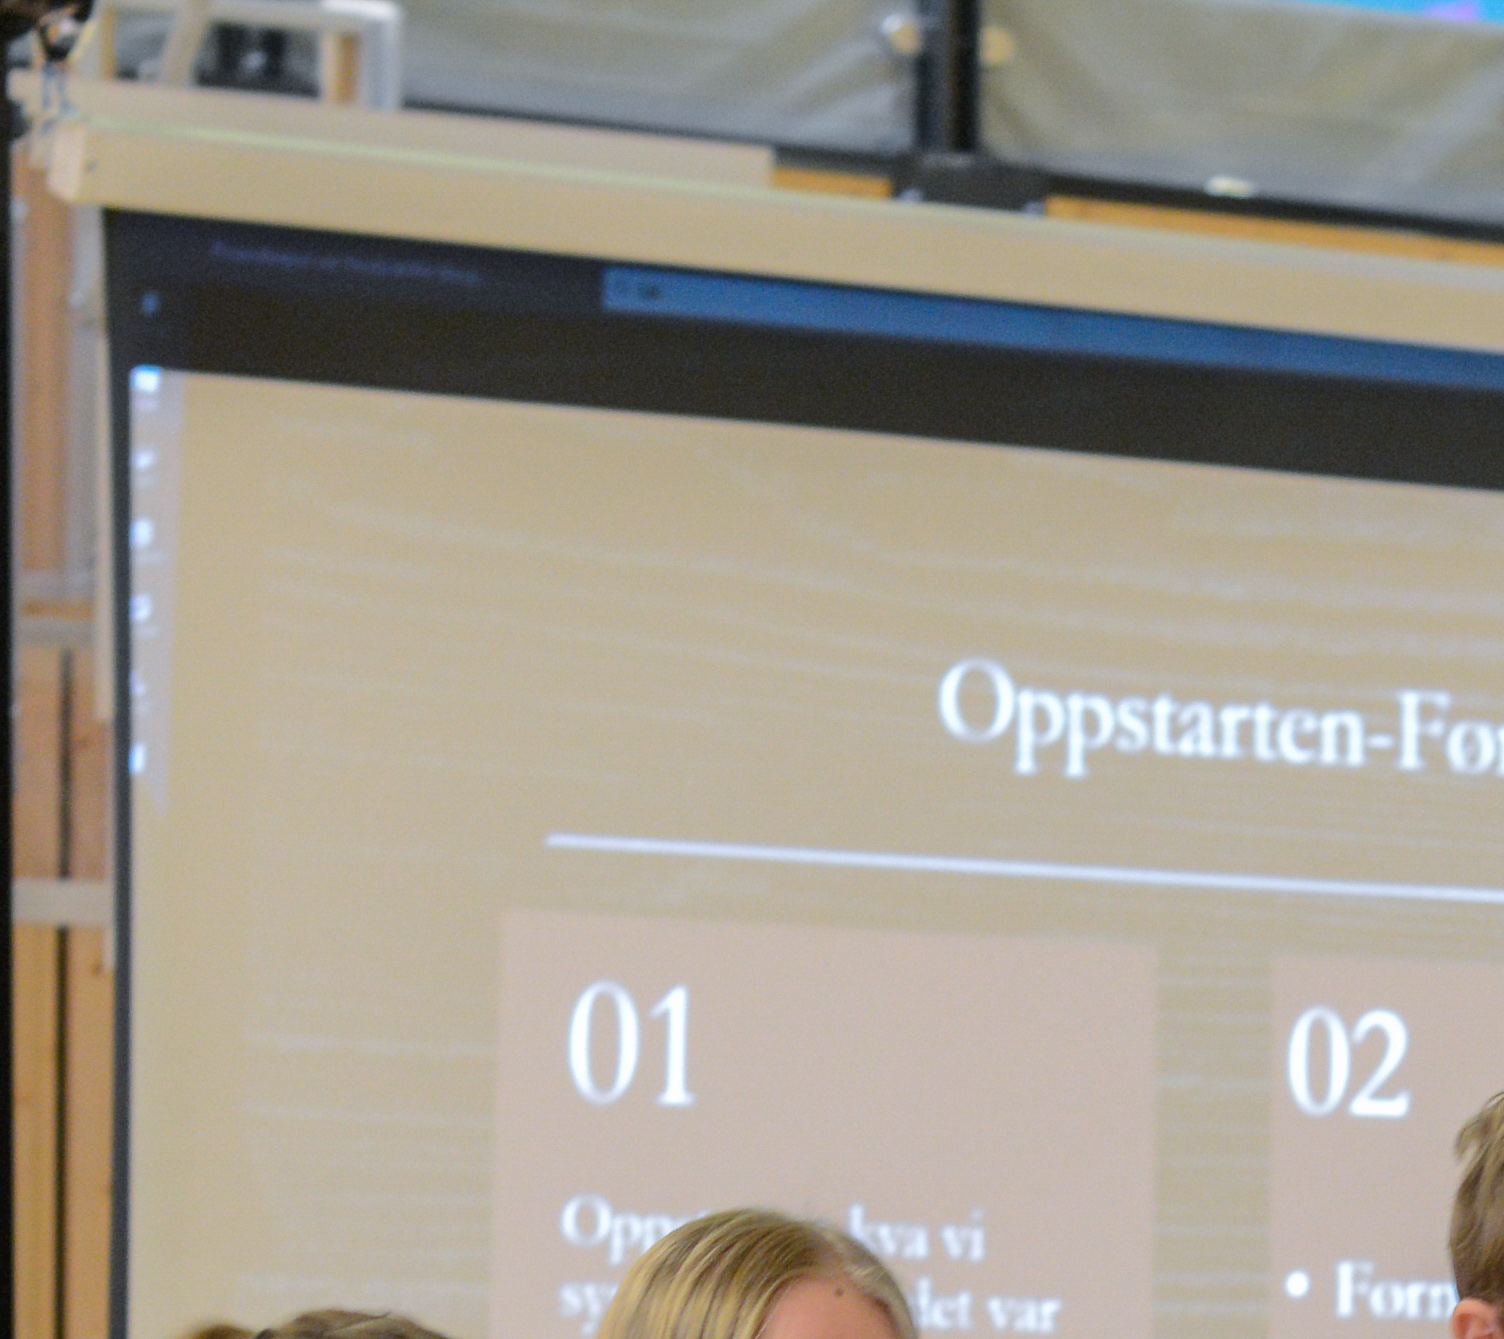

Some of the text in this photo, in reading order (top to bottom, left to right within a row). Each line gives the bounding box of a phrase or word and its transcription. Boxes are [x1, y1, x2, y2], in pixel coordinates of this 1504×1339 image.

[566, 980, 696, 1107] 01
[1287, 1006, 1412, 1118] 02
[941, 1207, 986, 1263] vi
[987, 1295, 1063, 1335] var
